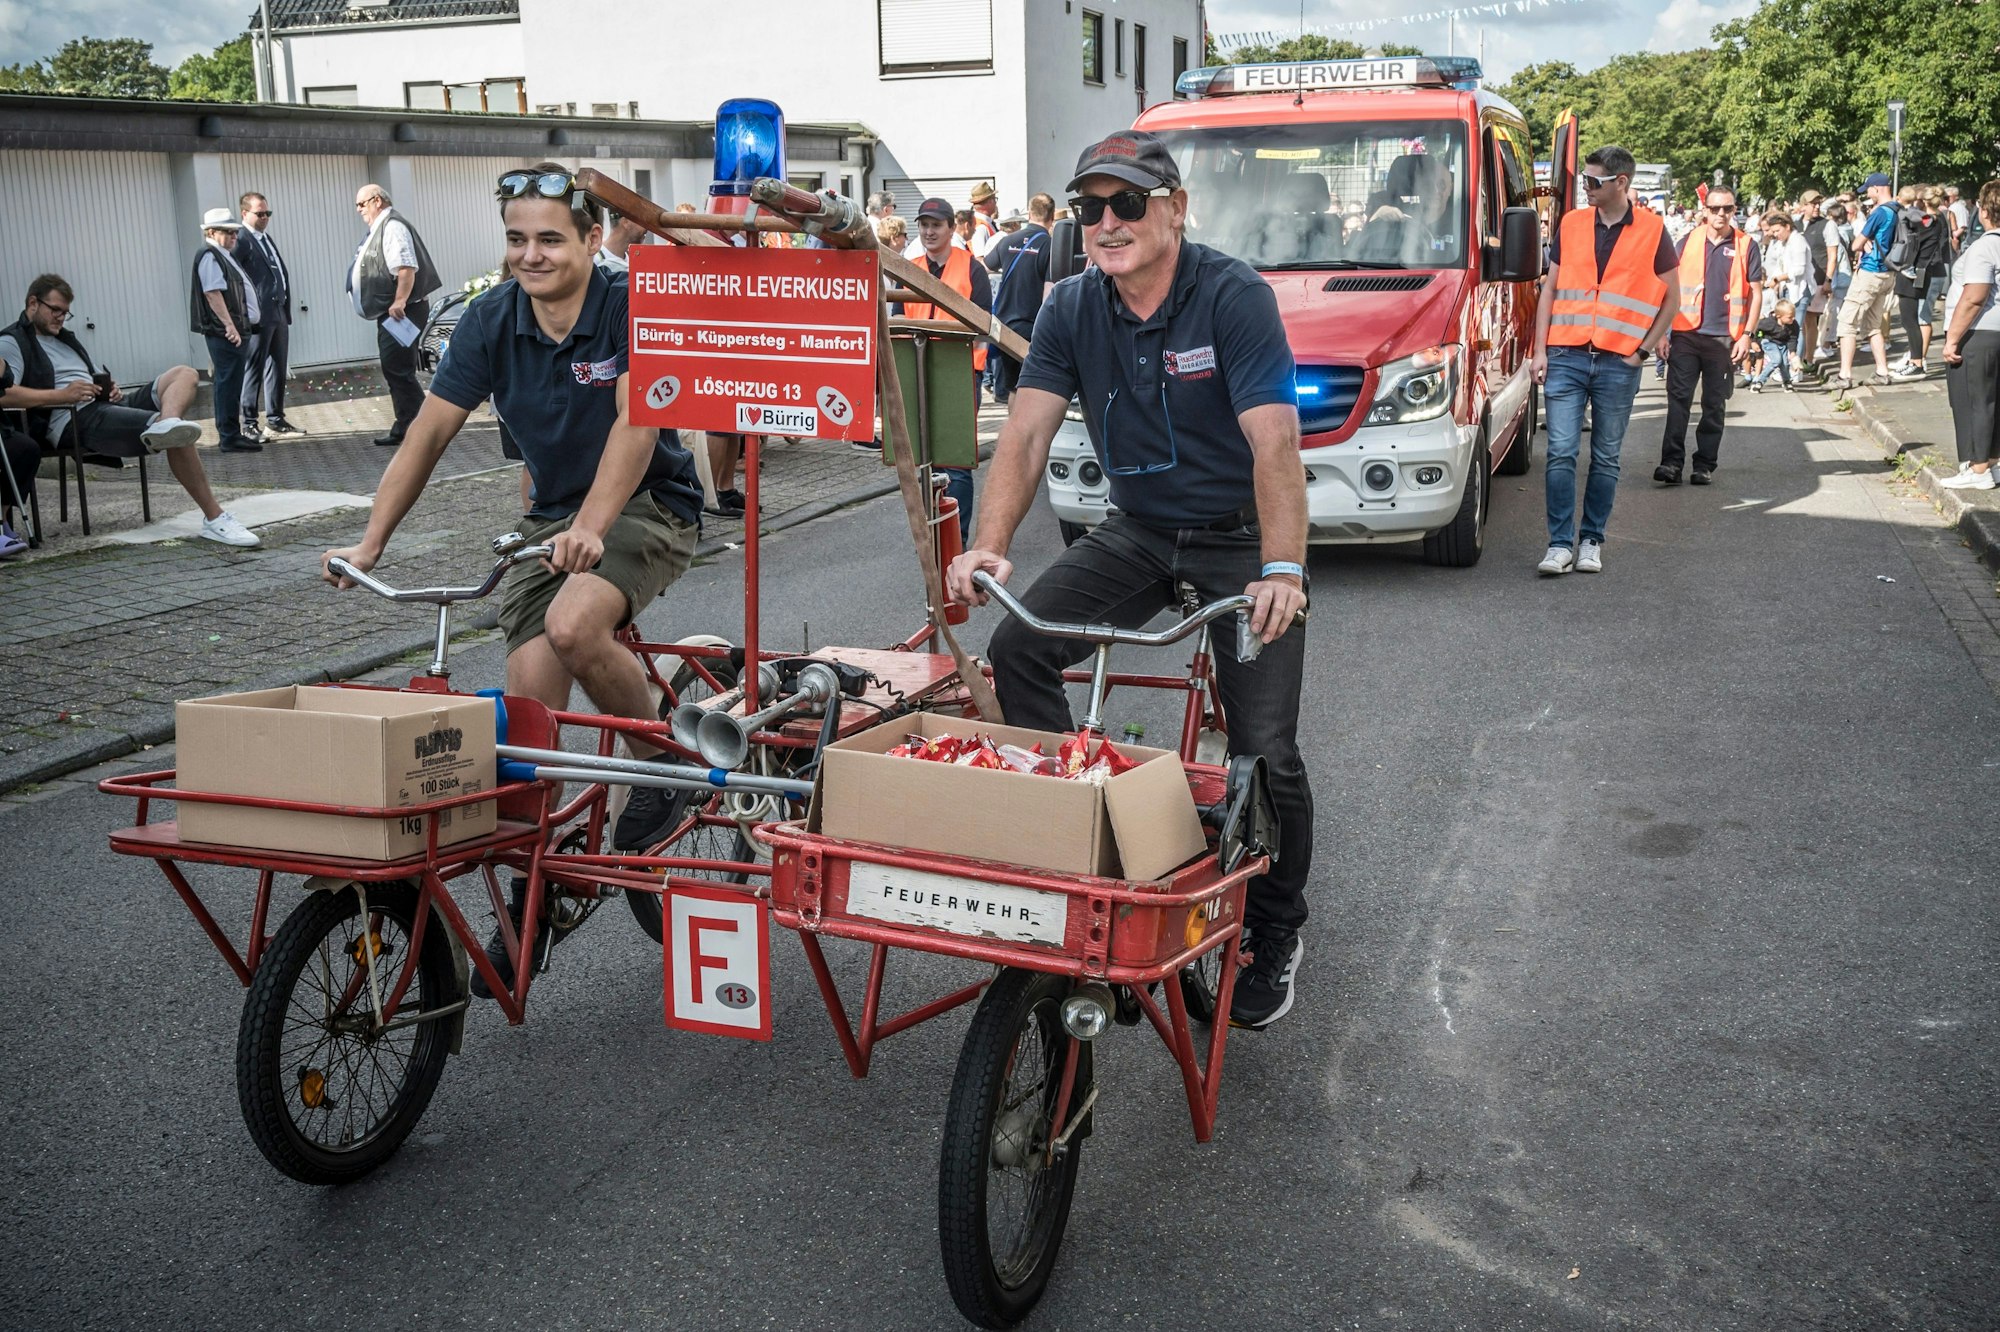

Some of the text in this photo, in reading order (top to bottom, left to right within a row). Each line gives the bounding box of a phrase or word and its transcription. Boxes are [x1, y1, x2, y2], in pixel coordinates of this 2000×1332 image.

[1245, 62, 1404, 87] FEUERWEHR
[635, 272, 869, 301] FEUERWEHR LEVERKUSEN
[639, 328, 684, 346] Bürrig
[697, 330, 786, 350] Küppersteg
[801, 335, 865, 351] Manfort
[652, 380, 674, 403] 13
[694, 376, 802, 400] LÖSCHZUG 13
[825, 393, 847, 418] 13
[763, 409, 815, 431] Bürrig
[422, 753, 457, 768] Erdnussflips
[420, 779, 437, 795] 100
[439, 776, 460, 791] Stück
[400, 816, 422, 835] 1kg
[884, 886, 1030, 921] FEUERWEHR
[688, 915, 739, 1004] F
[724, 987, 748, 1004] 13
